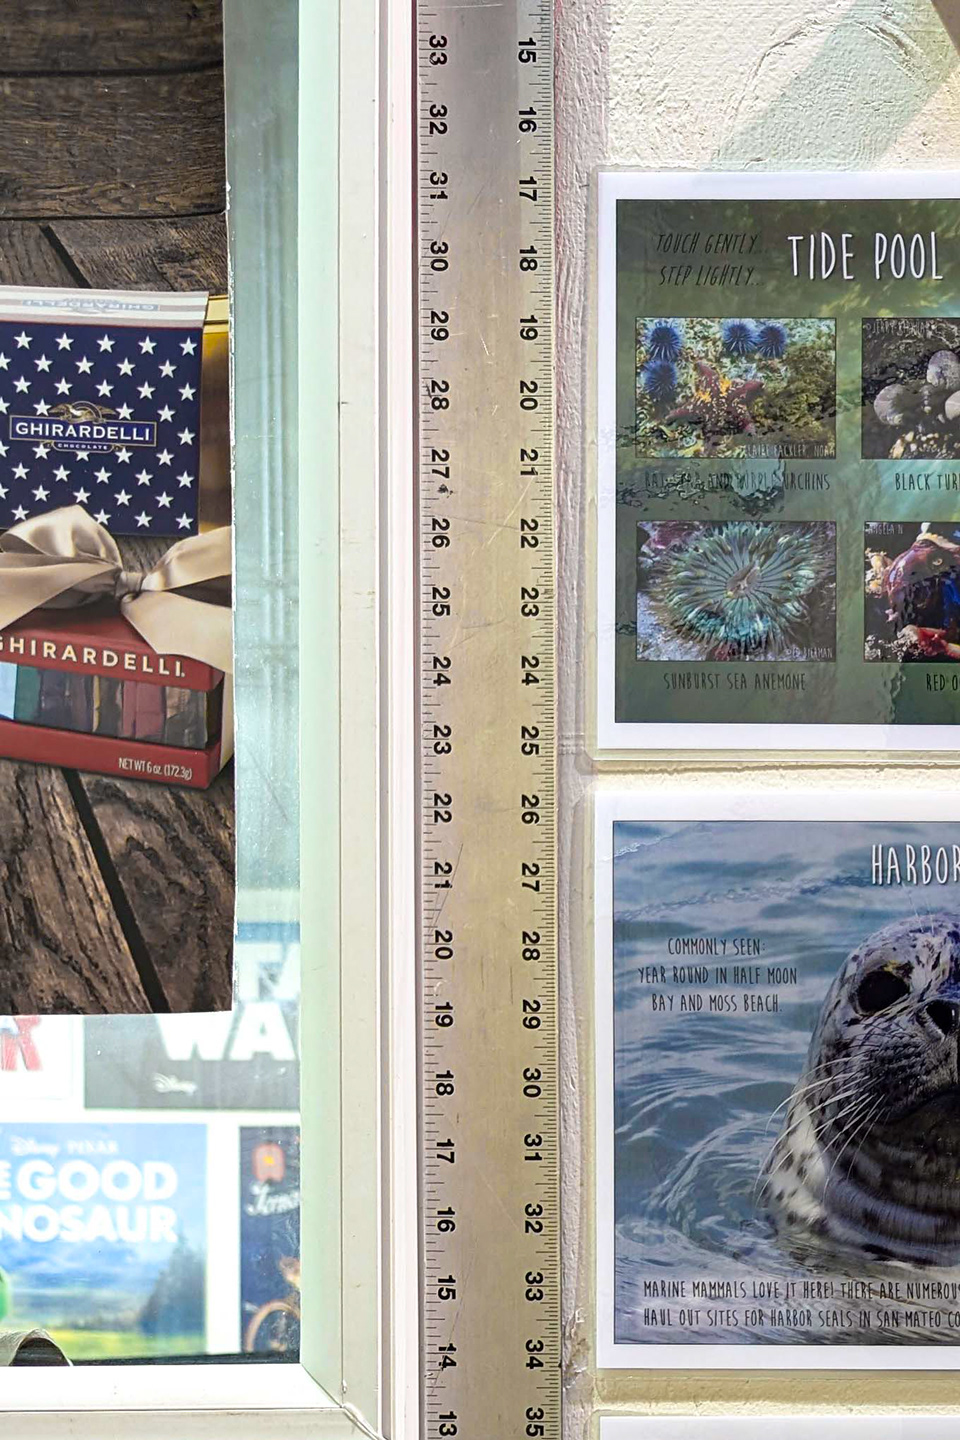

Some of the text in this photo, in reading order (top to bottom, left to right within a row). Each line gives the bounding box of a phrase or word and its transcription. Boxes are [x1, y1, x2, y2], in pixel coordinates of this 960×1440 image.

[519, 38, 536, 65] 15
[429, 104, 448, 136] 32
[657, 232, 698, 254] TOUCH
[787, 232, 854, 280] TIDE
[875, 231, 943, 280] POOL
[659, 265, 691, 286] STEP
[520, 316, 537, 341] 19
[431, 379, 449, 411] 28
[15, 422, 150, 441] GHIRARDELLI
[895, 473, 930, 491] BLACK
[521, 587, 538, 617] 23
[434, 655, 451, 686] 24
[663, 673, 806, 691] SUNBURST SEA ANEMONE
[926, 673, 945, 692] RED
[119, 758, 134, 770] NET
[135, 759, 146, 771] WT
[147, 761, 152, 773] 6
[436, 929, 453, 961] 20
[668, 938, 766, 955] COMMONLY SEEN:
[638, 966, 797, 984] YEAR ROUND IN HALF MOON
[523, 1000, 540, 1030] 29
[652, 994, 783, 1012] BAY AND MOSS BEACH.
[17, 1160, 178, 1201] GOOD
[437, 1206, 455, 1233] 16
[525, 1271, 543, 1302] 33
